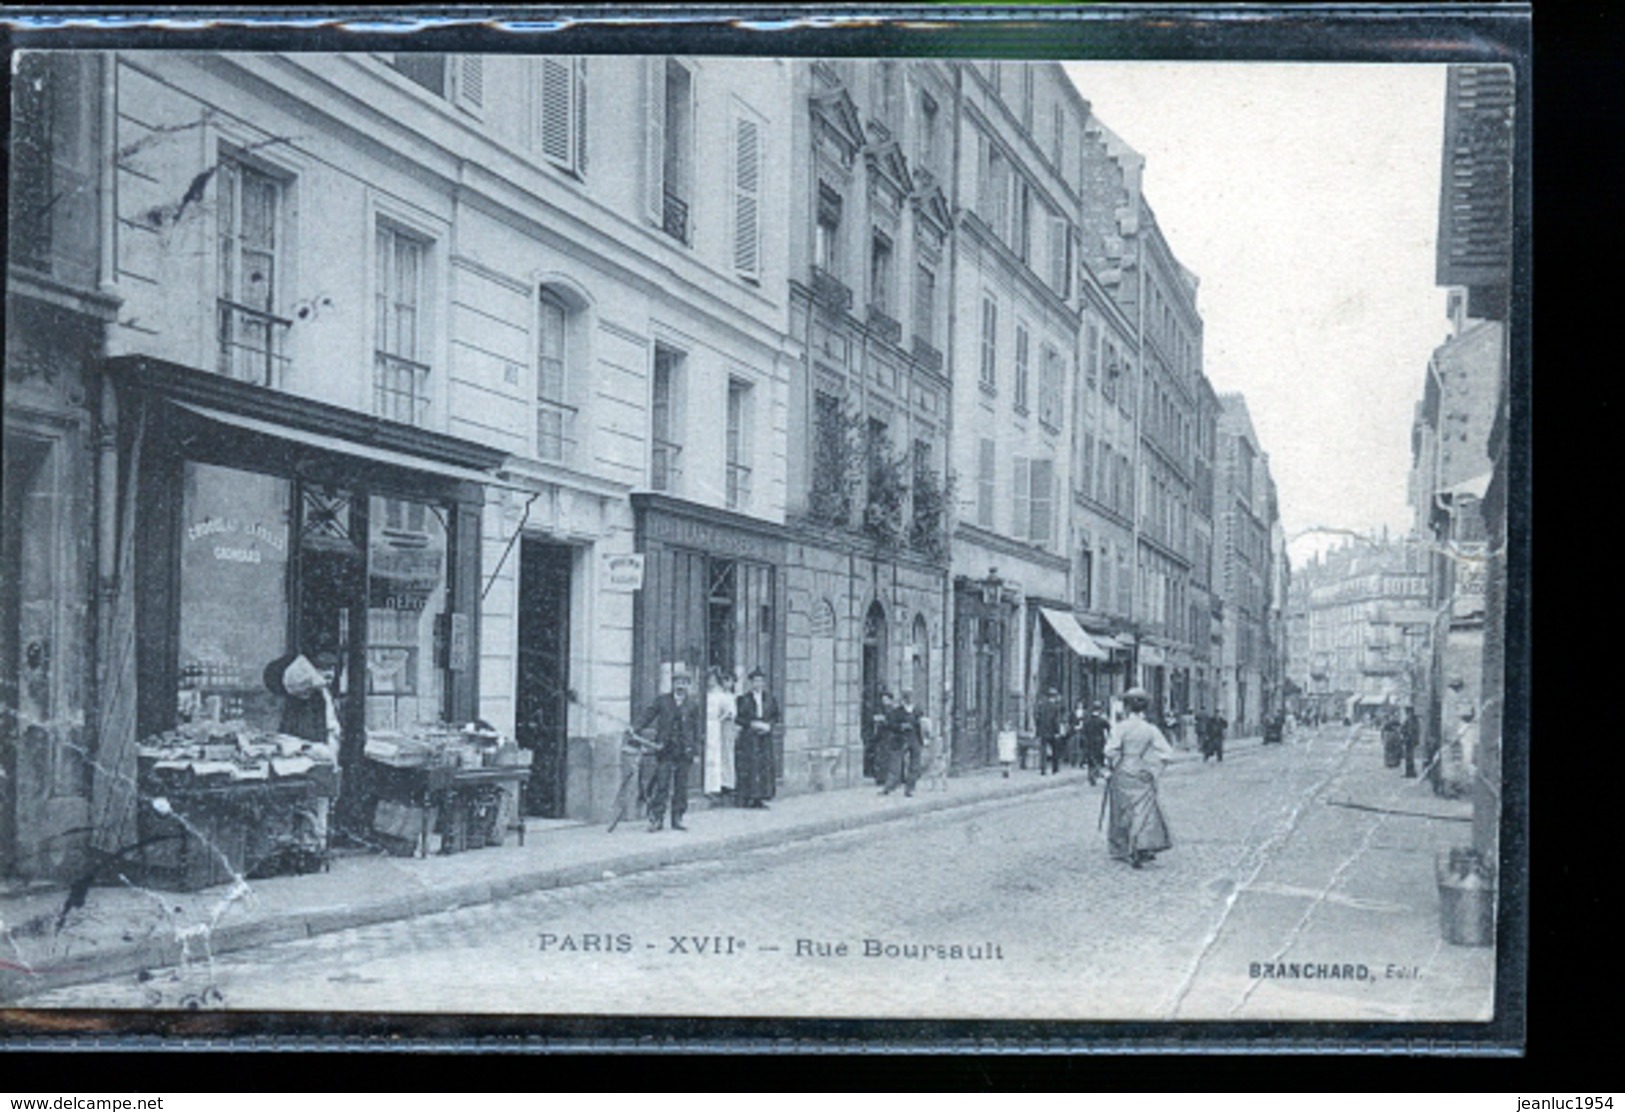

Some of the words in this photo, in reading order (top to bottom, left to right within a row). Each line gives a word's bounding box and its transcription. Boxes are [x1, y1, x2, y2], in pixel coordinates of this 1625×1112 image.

[537, 933, 633, 952] PARIS
[795, 938, 849, 957] Rue
[862, 939, 1004, 961] Boursault
[1249, 962, 1376, 982] BRANCHARD,
